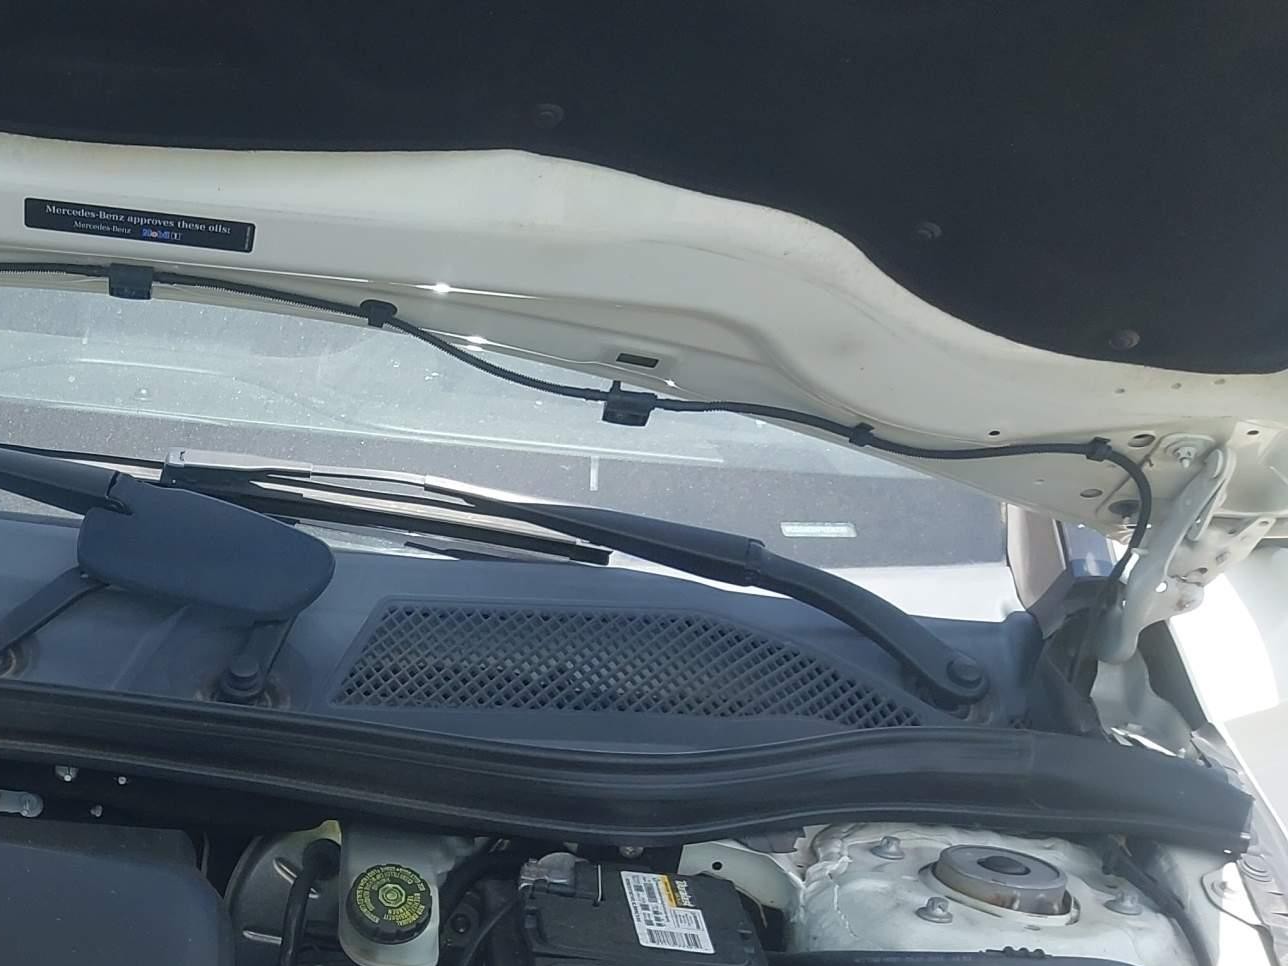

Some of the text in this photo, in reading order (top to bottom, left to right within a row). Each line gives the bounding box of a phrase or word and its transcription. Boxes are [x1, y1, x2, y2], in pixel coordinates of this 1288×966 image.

[45, 204, 231, 235] Mercedes-Benz approves these oils:
[73, 220, 132, 235] Mercedes-Benz
